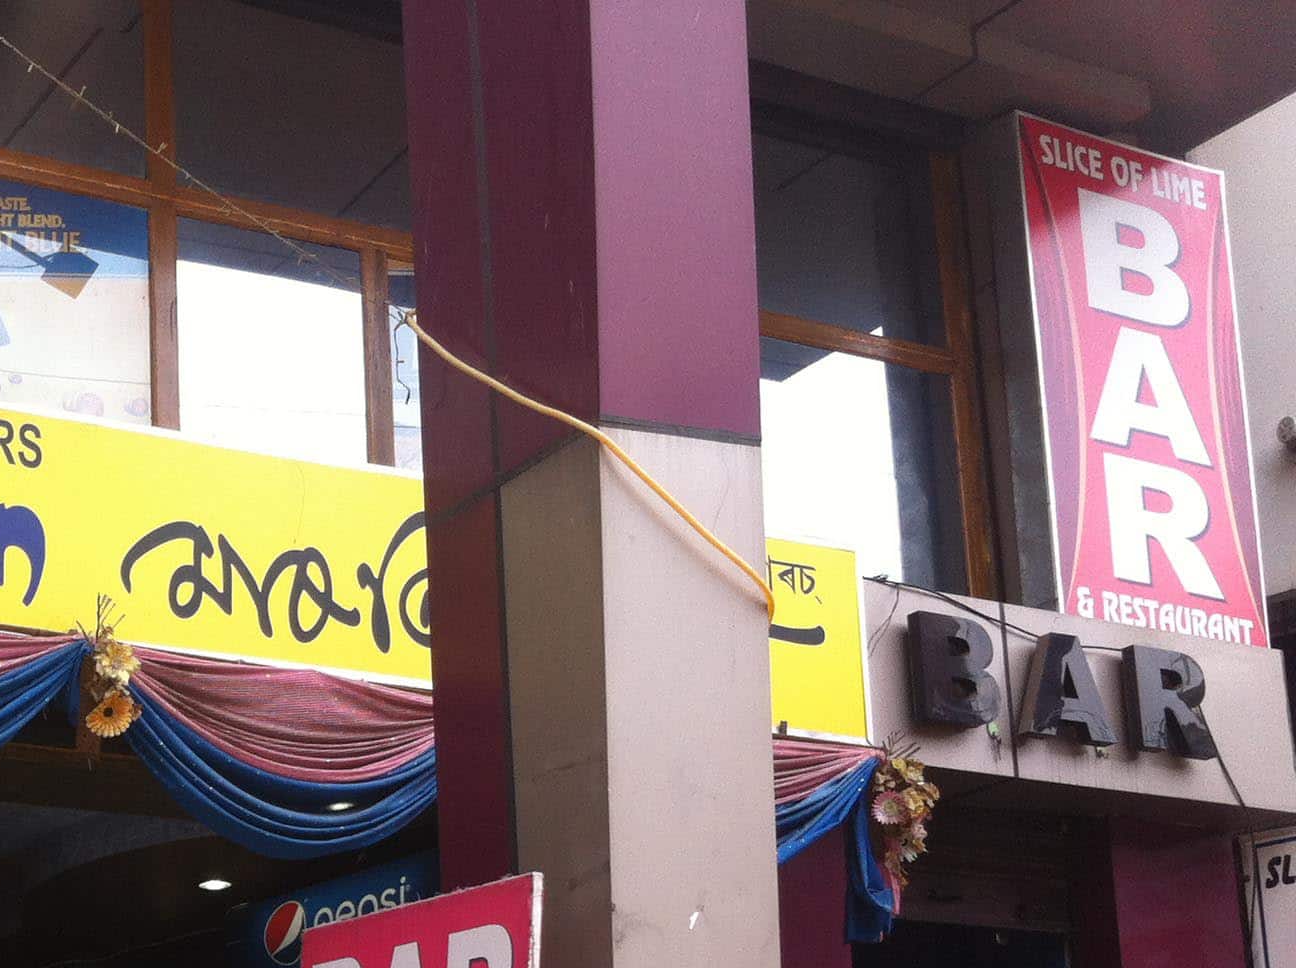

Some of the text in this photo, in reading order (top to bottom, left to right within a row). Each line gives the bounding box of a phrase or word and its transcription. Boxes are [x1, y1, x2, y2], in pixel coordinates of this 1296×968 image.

[1039, 134, 1207, 210] SLICE OF LIME
[1077, 187, 1229, 602] BAR
[1077, 587, 1254, 646] & RESTAURANT
[907, 611, 1215, 760] BAR
